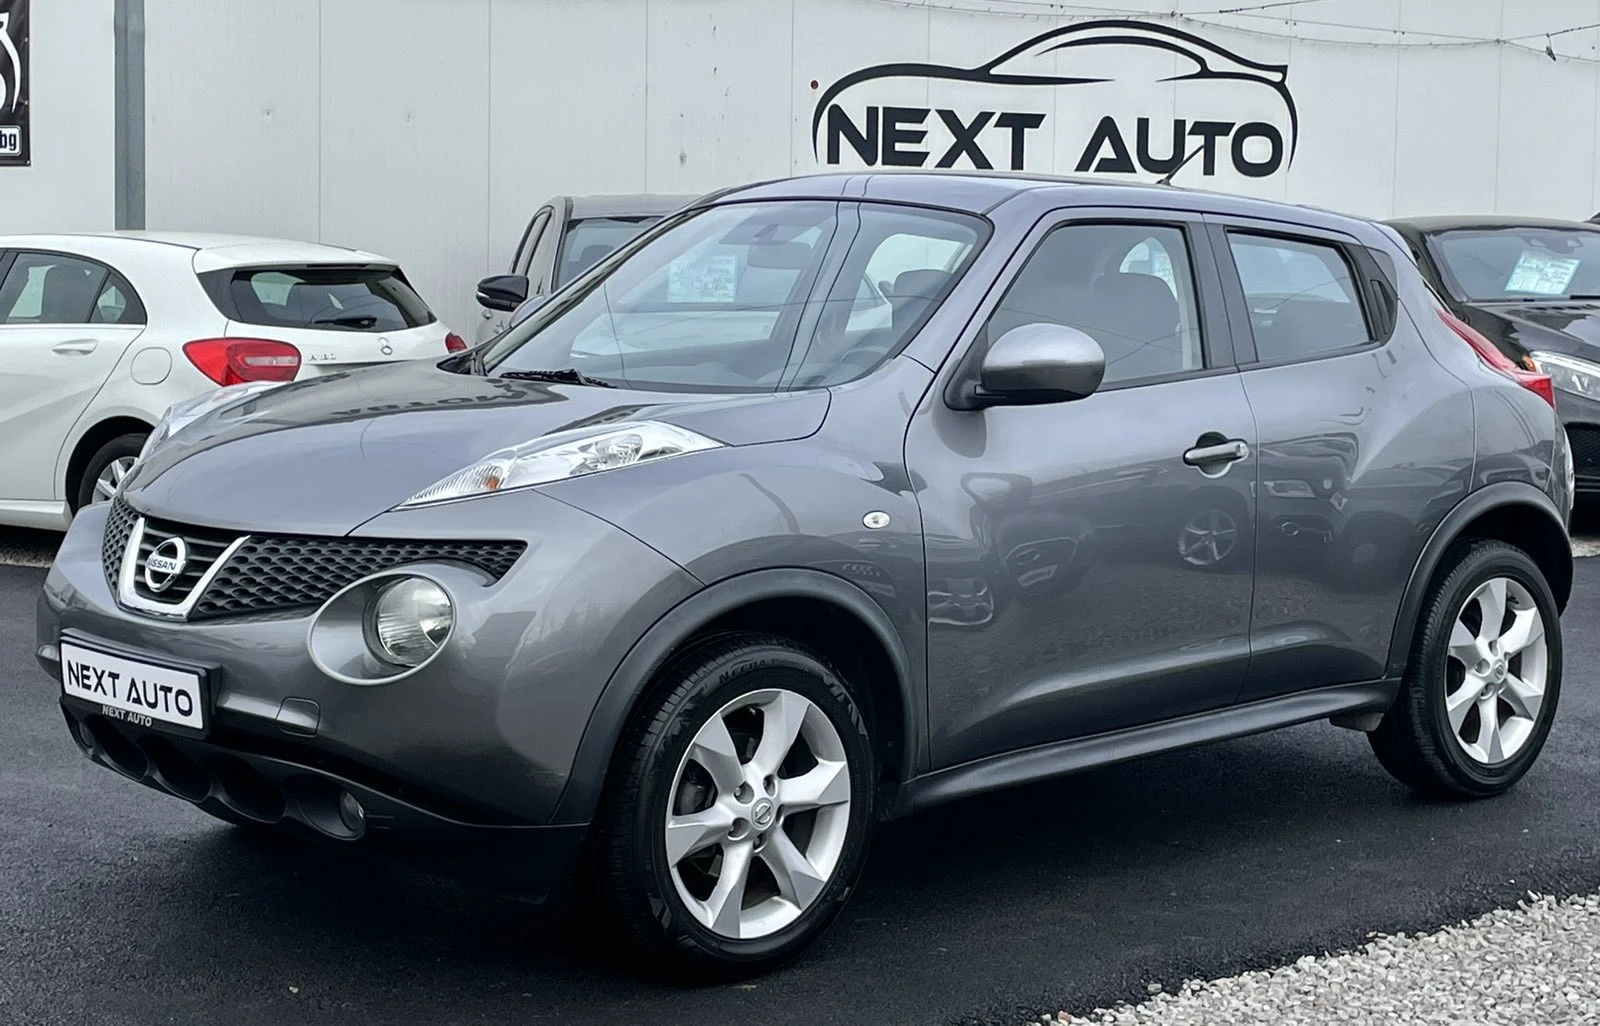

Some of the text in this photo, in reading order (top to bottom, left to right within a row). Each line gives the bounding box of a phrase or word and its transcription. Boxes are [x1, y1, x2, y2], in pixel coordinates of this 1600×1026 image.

[827, 103, 1283, 178] NEXT AUTO
[67, 660, 193, 717] NEXT AUTO
[102, 704, 153, 727] NEXT AUTO
